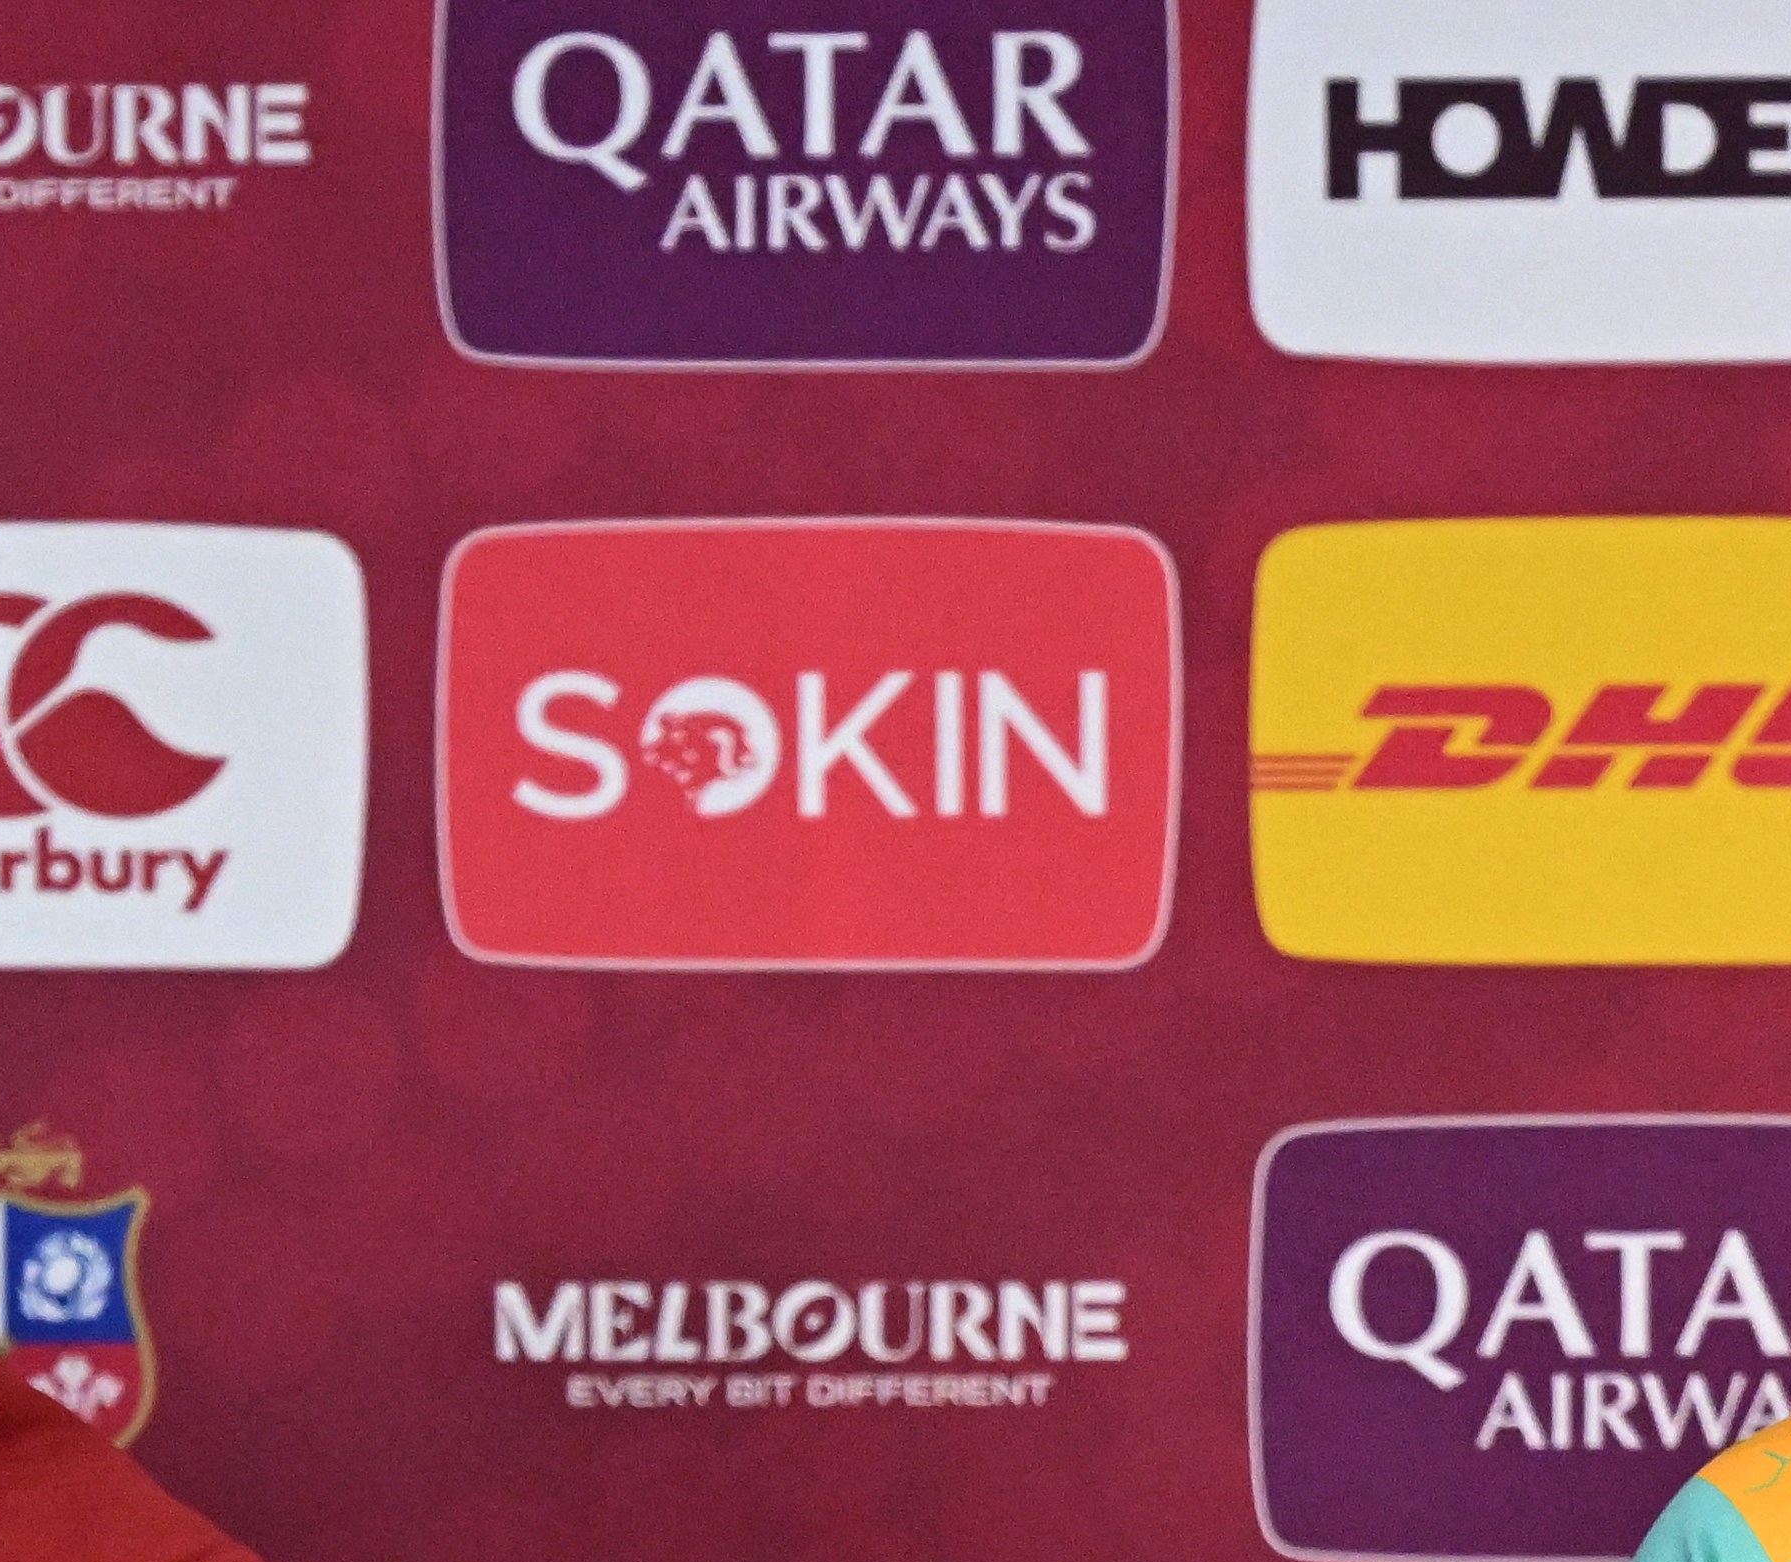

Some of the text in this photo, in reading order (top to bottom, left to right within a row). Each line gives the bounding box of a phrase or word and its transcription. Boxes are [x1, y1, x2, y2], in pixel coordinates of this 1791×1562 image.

[512, 30, 1091, 192] QATAR
[659, 172, 1099, 252] AIRWAYS
[512, 670, 1107, 819] SOKIN
[494, 1280, 1128, 1362] MELBOURNE
[566, 1374, 1052, 1408] EVERY BIT DIFFERENT
